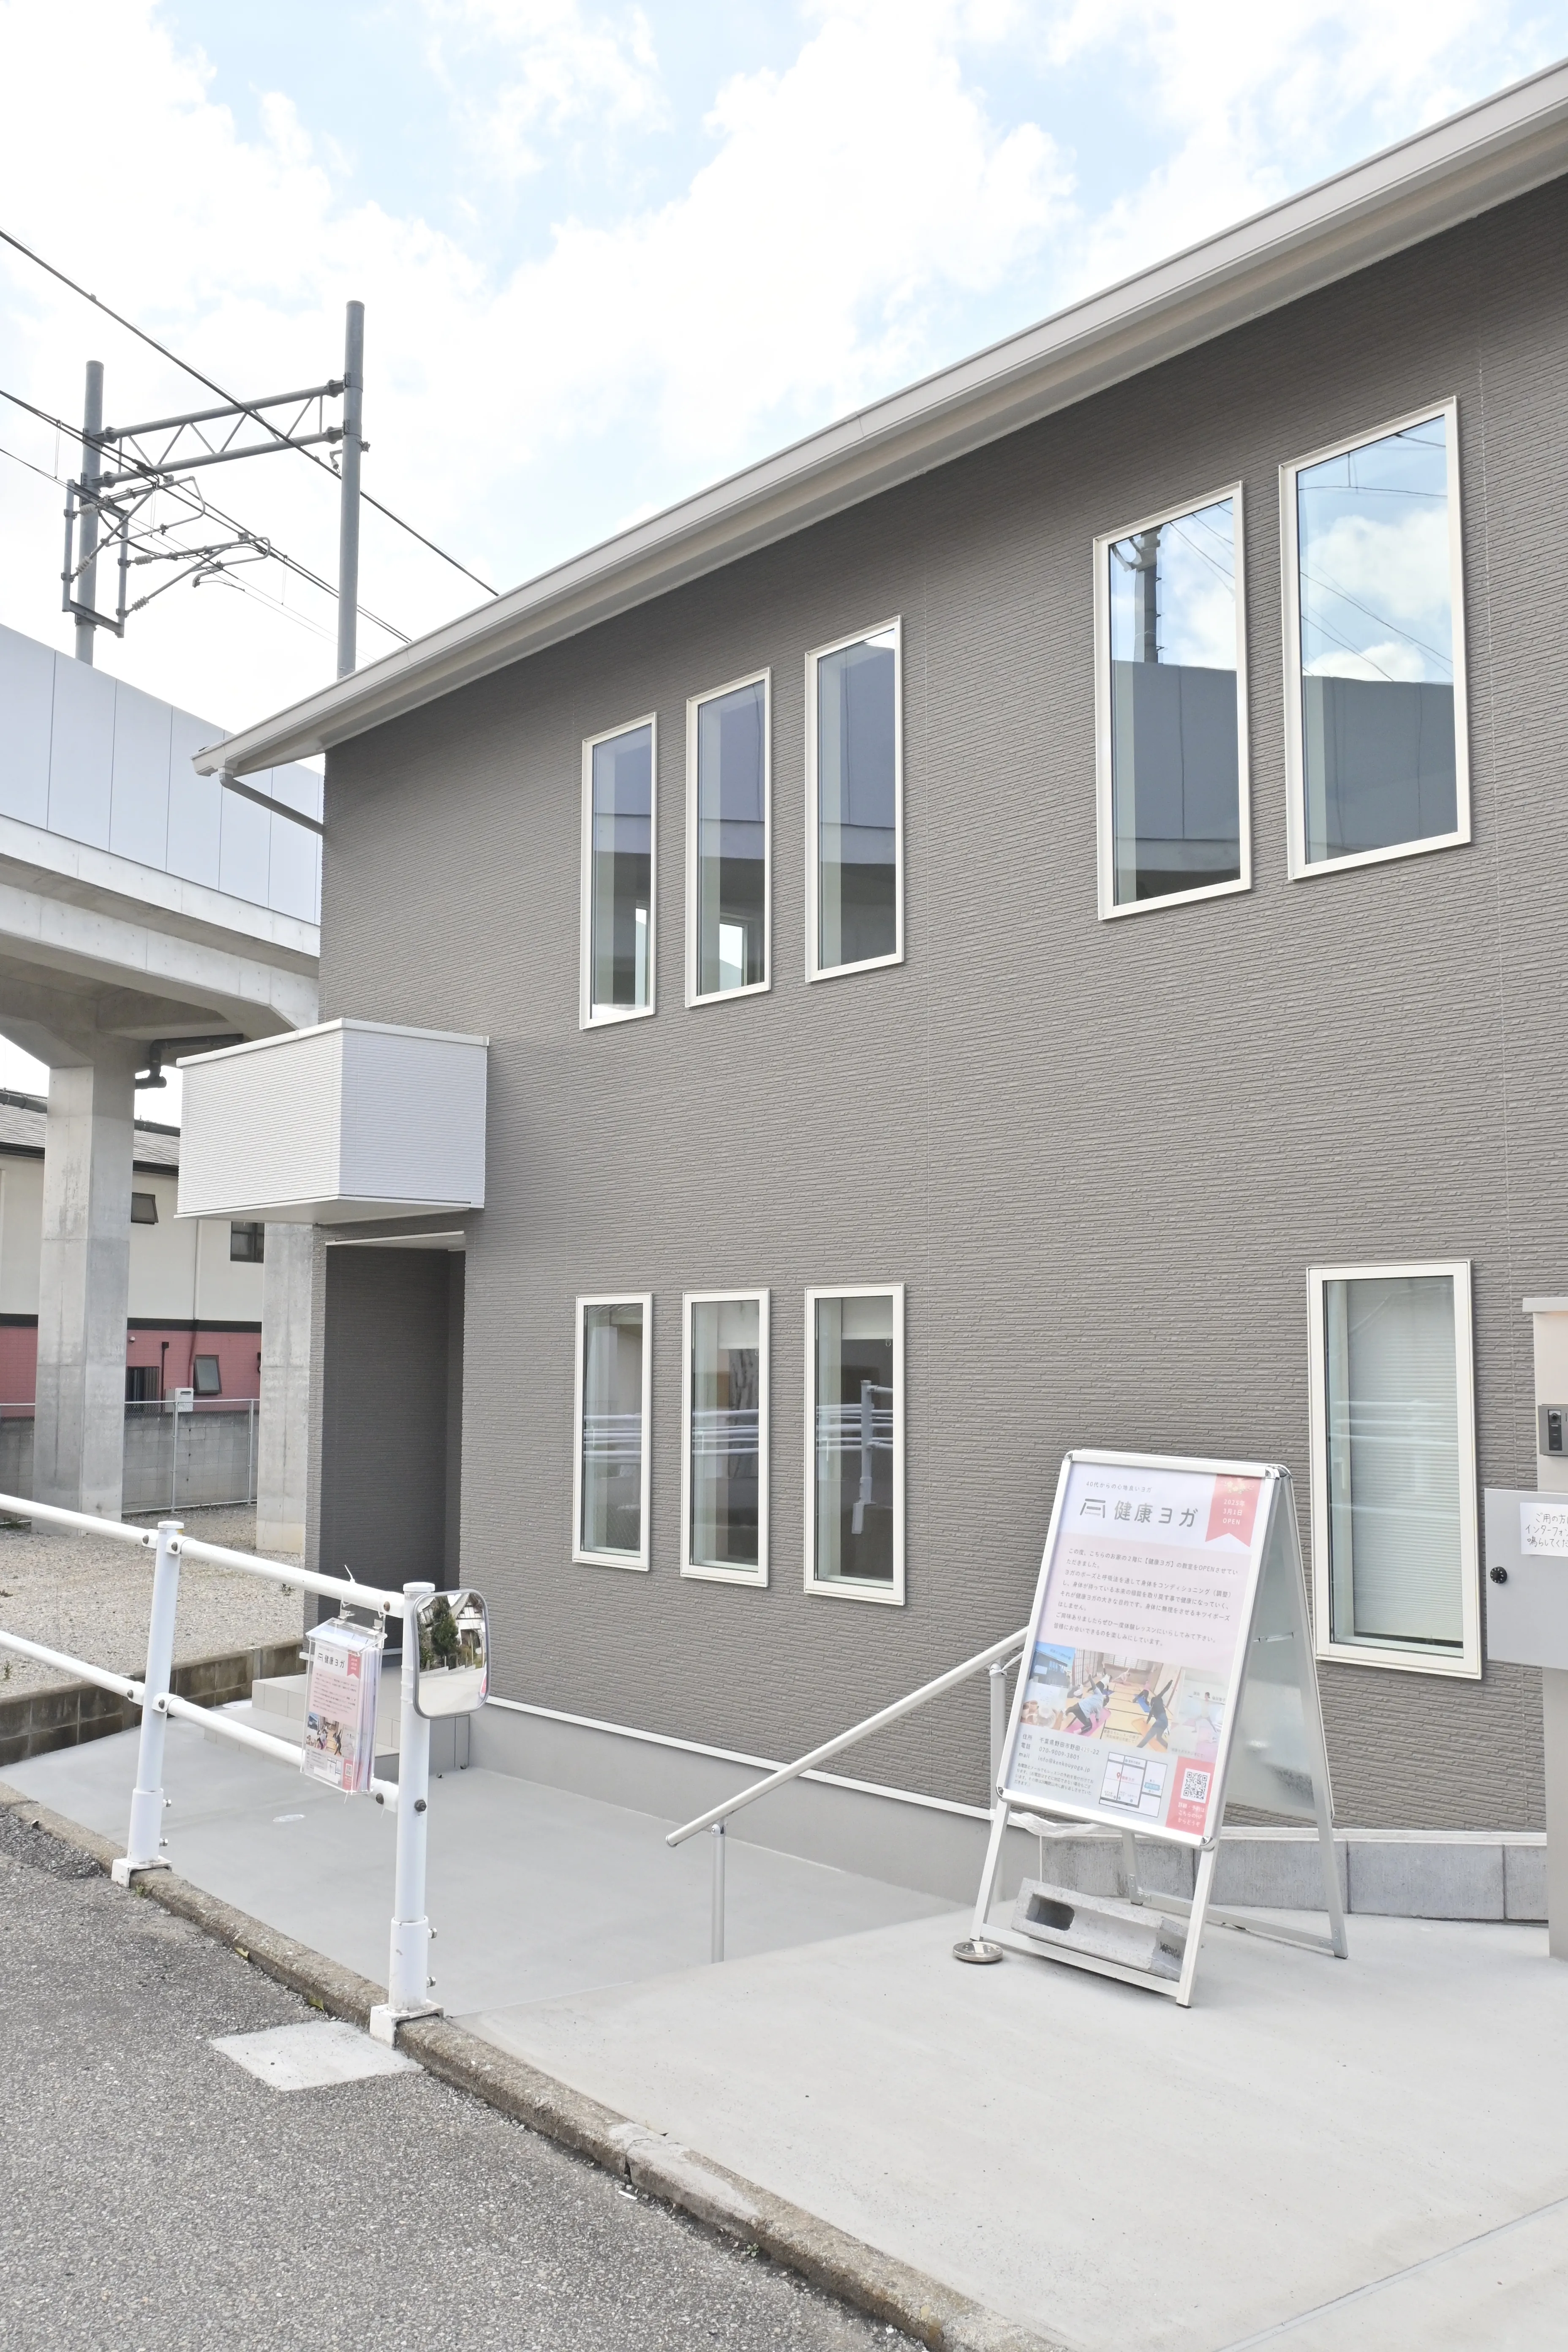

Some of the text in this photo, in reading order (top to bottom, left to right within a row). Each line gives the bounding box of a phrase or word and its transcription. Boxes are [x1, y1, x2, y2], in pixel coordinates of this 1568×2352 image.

[1086, 1481, 1152, 1493] 40代からの心地良いヨガ
[1223, 1498, 1246, 1507] 2025年
[1113, 1500, 1198, 1527] 健康ヨガ
[1222, 1508, 1243, 1516] 3月1日
[1066, 1558, 1100, 1569] ただきました。
[1058, 1601, 1087, 1612] はしません。
[324, 1654, 345, 1668] 健康ヨガ
[1039, 1737, 1100, 1756] 千葉県野田市野田429-22
[1039, 1746, 1080, 1760] 070-9009-3801
[1037, 1755, 1091, 1773] info@kenkouyoga.jp
[1178, 1810, 1203, 1819] こちらのHP
[1178, 1817, 1201, 1827] からどうぞ
